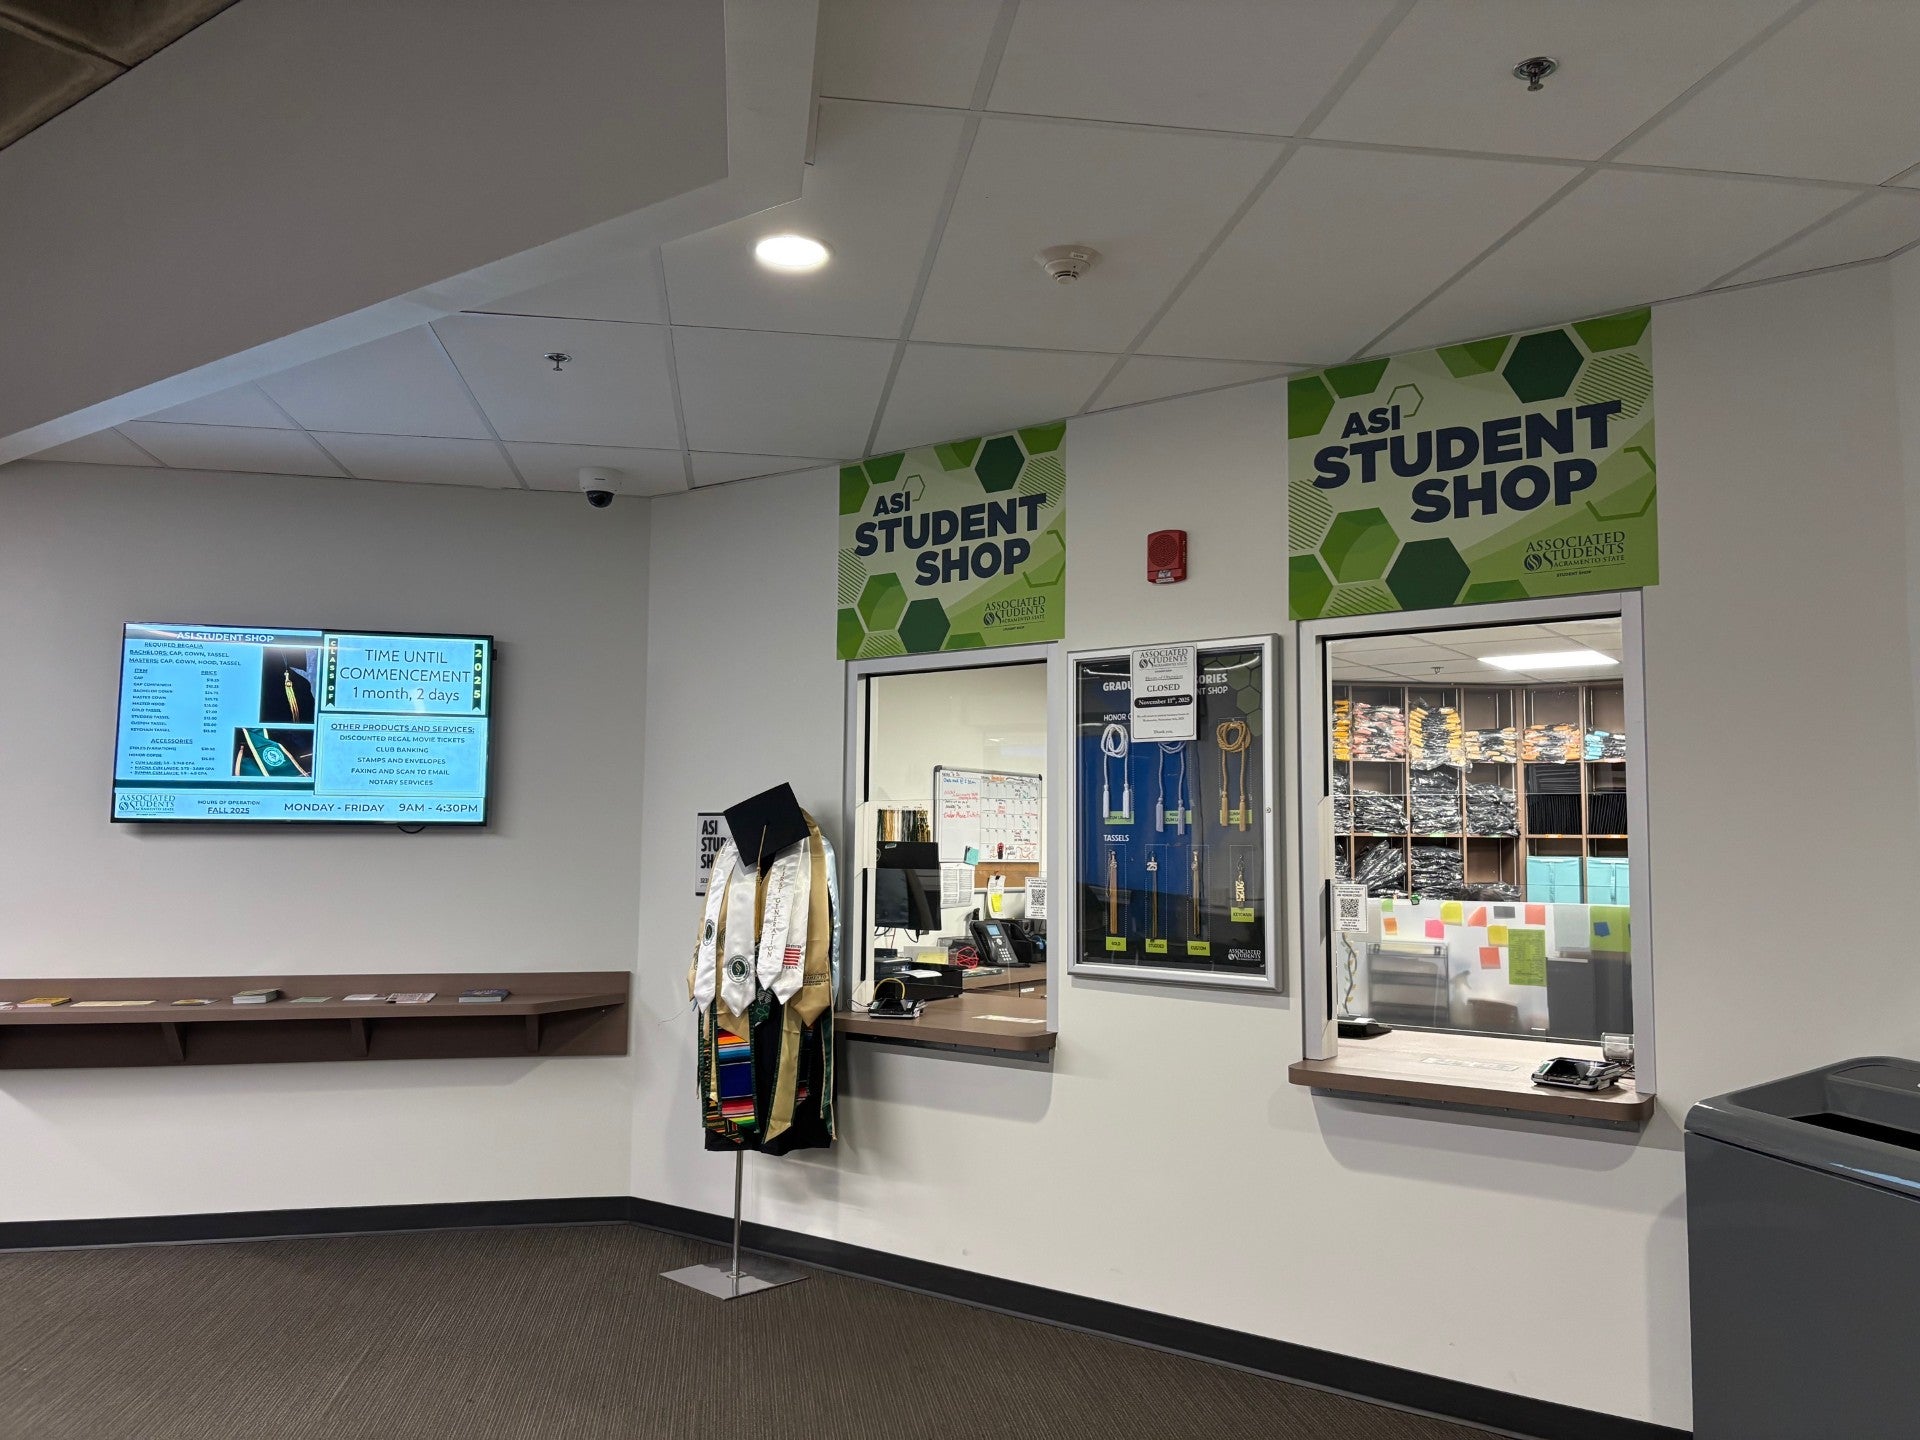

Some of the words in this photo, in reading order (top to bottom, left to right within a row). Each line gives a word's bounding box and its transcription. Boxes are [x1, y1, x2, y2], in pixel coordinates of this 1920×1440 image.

[1340, 404, 1400, 439] ASI
[1312, 399, 1622, 489] STUDENT
[1410, 458, 1598, 524] SHOP
[872, 490, 911, 517] ASI
[854, 492, 1047, 557] STUDENT
[1525, 531, 1626, 553] ASSOCIATED
[914, 537, 1031, 586] SHOP
[1542, 542, 1625, 568] STUDENTS
[1602, 554, 1625, 562] STATE
[985, 595, 1046, 612] ASSOCIATED
[995, 604, 1045, 623] STUDENTS
[195, 632, 244, 642] STUDENT
[244, 634, 275, 644] SHOP
[365, 649, 400, 662] TIME
[404, 650, 448, 663] UNTIL
[1140, 648, 1188, 660] ASSOCIATED
[1148, 655, 1188, 667] STUDENTS
[340, 667, 472, 683] COMMENCEMENT
[473, 649, 483, 699] 2025
[1197, 672, 1228, 684] ORIES
[328, 685, 334, 700] OF
[1146, 683, 1180, 692] CLOSED
[1208, 685, 1228, 695] SHOP
[354, 687, 358, 698] 1
[362, 687, 412, 702] month,
[416, 688, 424, 700] 2
[428, 688, 460, 704] days
[1138, 698, 1166, 706] November
[1104, 713, 1127, 722] HONOR
[331, 723, 360, 731] OTHER
[363, 724, 410, 732] PRODUCTS
[432, 726, 475, 734] SERVICES:
[120, 794, 176, 802] ASSOCIATED
[130, 800, 174, 810] STUDENTS
[284, 803, 335, 812] MONDAY
[344, 804, 385, 812] FRIDAY
[398, 804, 425, 812] 9AM
[436, 804, 478, 813] 4:30PM
[701, 819, 718, 836] ASI
[1103, 834, 1130, 842] TASSELS
[1146, 861, 1158, 872] 25
